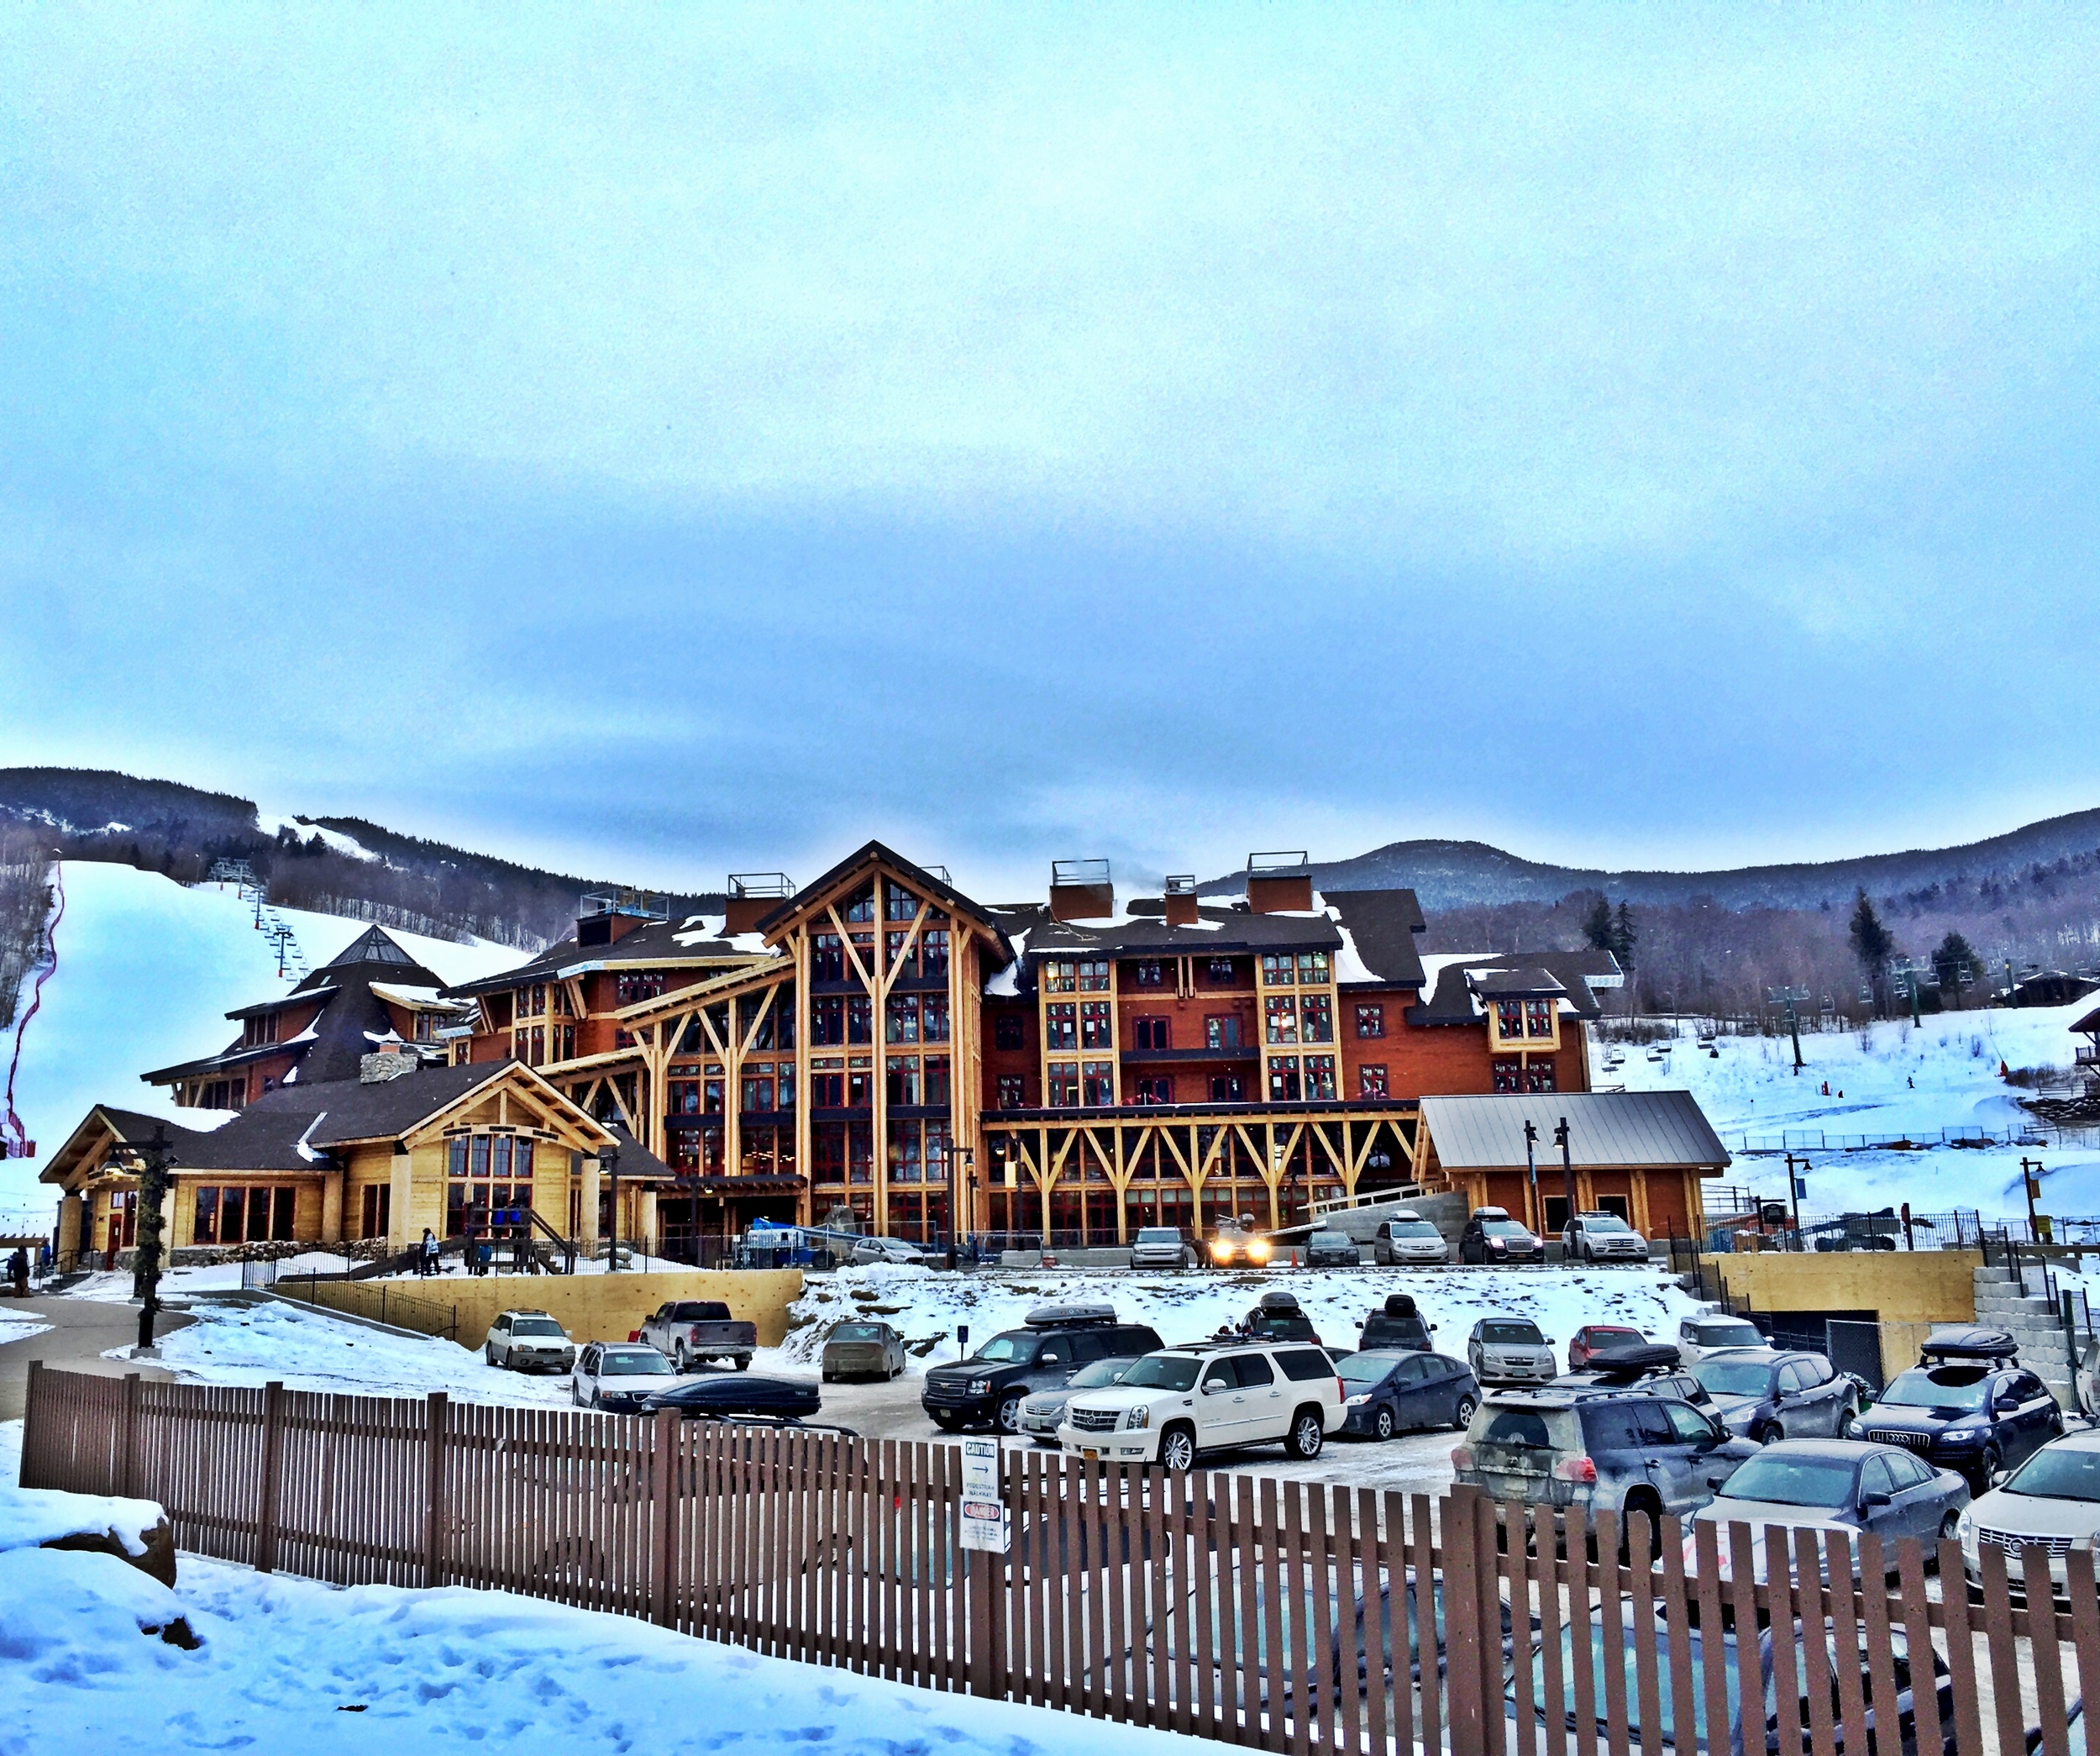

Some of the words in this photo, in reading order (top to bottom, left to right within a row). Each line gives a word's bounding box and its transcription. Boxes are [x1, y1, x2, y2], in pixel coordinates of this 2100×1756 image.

[966, 1443, 994, 1457] CAUTION
[966, 1482, 995, 1491] PEDESTRIAN
[969, 1490, 992, 1498] WALKWAY
